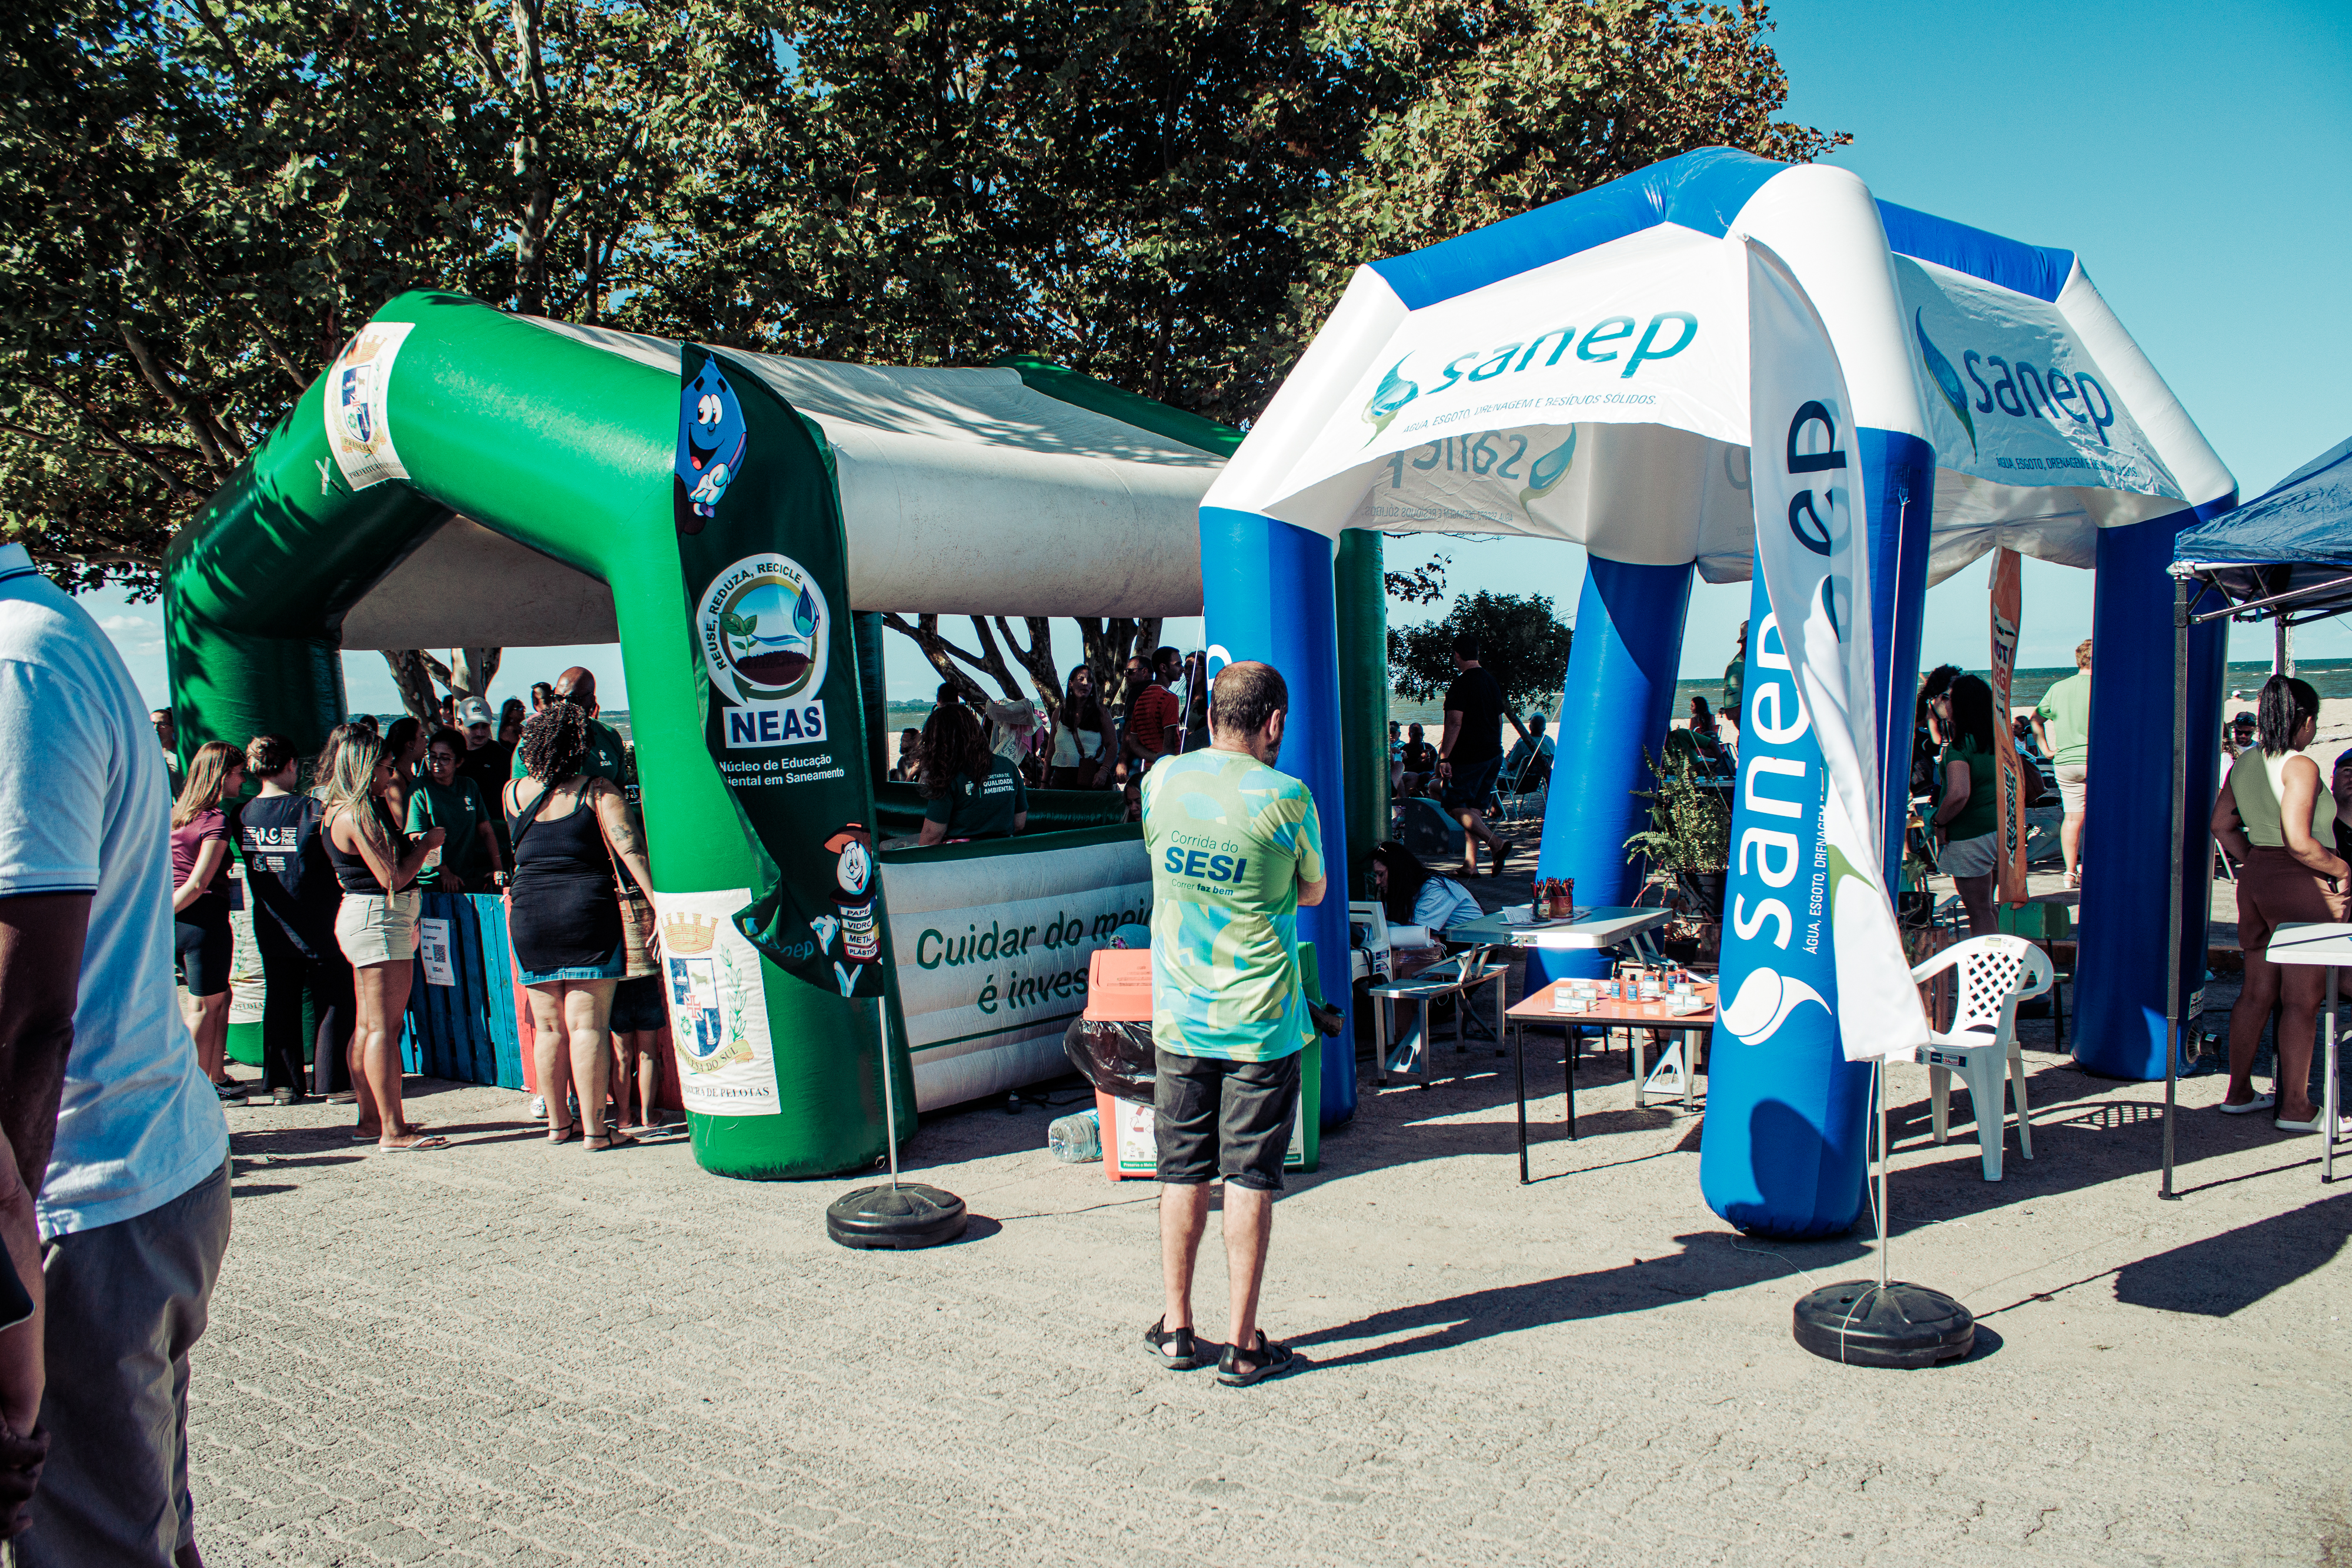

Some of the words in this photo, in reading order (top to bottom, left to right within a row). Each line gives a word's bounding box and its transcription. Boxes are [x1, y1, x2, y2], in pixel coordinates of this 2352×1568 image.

[1425, 311, 1698, 395] sanep
[1474, 399, 1534, 416] DRENAGEM
[1535, 398, 1544, 407] E
[1545, 393, 1602, 407] RESÍDUOS
[1603, 392, 1657, 405] SÓLIDOS.
[1964, 349, 2114, 447] sanep
[2015, 458, 2047, 470] ESGOTO,
[2046, 457, 2087, 469] DRENAGEM
[756, 562, 802, 584] RECICLE
[708, 569, 755, 616] REDUZA,
[706, 620, 728, 671] REUSE,
[730, 706, 822, 744] NEAS
[719, 761, 760, 773] Núcleo
[763, 760, 779, 771] de
[781, 754, 832, 769] Educação
[728, 775, 761, 786] iental
[764, 776, 783, 785] em
[786, 767, 845, 784] Saneamento
[983, 778, 1013, 787] QUALIDADE
[984, 785, 1015, 794] AMBIENTAL
[1171, 830, 1217, 850] Corrida
[1221, 840, 1239, 853] do
[1164, 846, 1248, 884] SESI
[1171, 878, 1195, 891] Correr
[1197, 883, 1211, 893] faz
[1212, 886, 1234, 897] bem
[1809, 871, 1827, 916] ESGOTO,
[758, 932, 814, 961] sanep
[916, 920, 1037, 971] Cuidar
[1043, 911, 1084, 950] do
[1803, 920, 1822, 955] ÁGUA,
[977, 974, 998, 1014] é
[1007, 967, 1089, 1009] inves
[234, 1002, 265, 1011] PELOTA
[706, 1059, 719, 1071] DO
[720, 1047, 739, 1063] SUL
[707, 1088, 719, 1097] DE
[721, 1086, 770, 1098] PELOTAS
